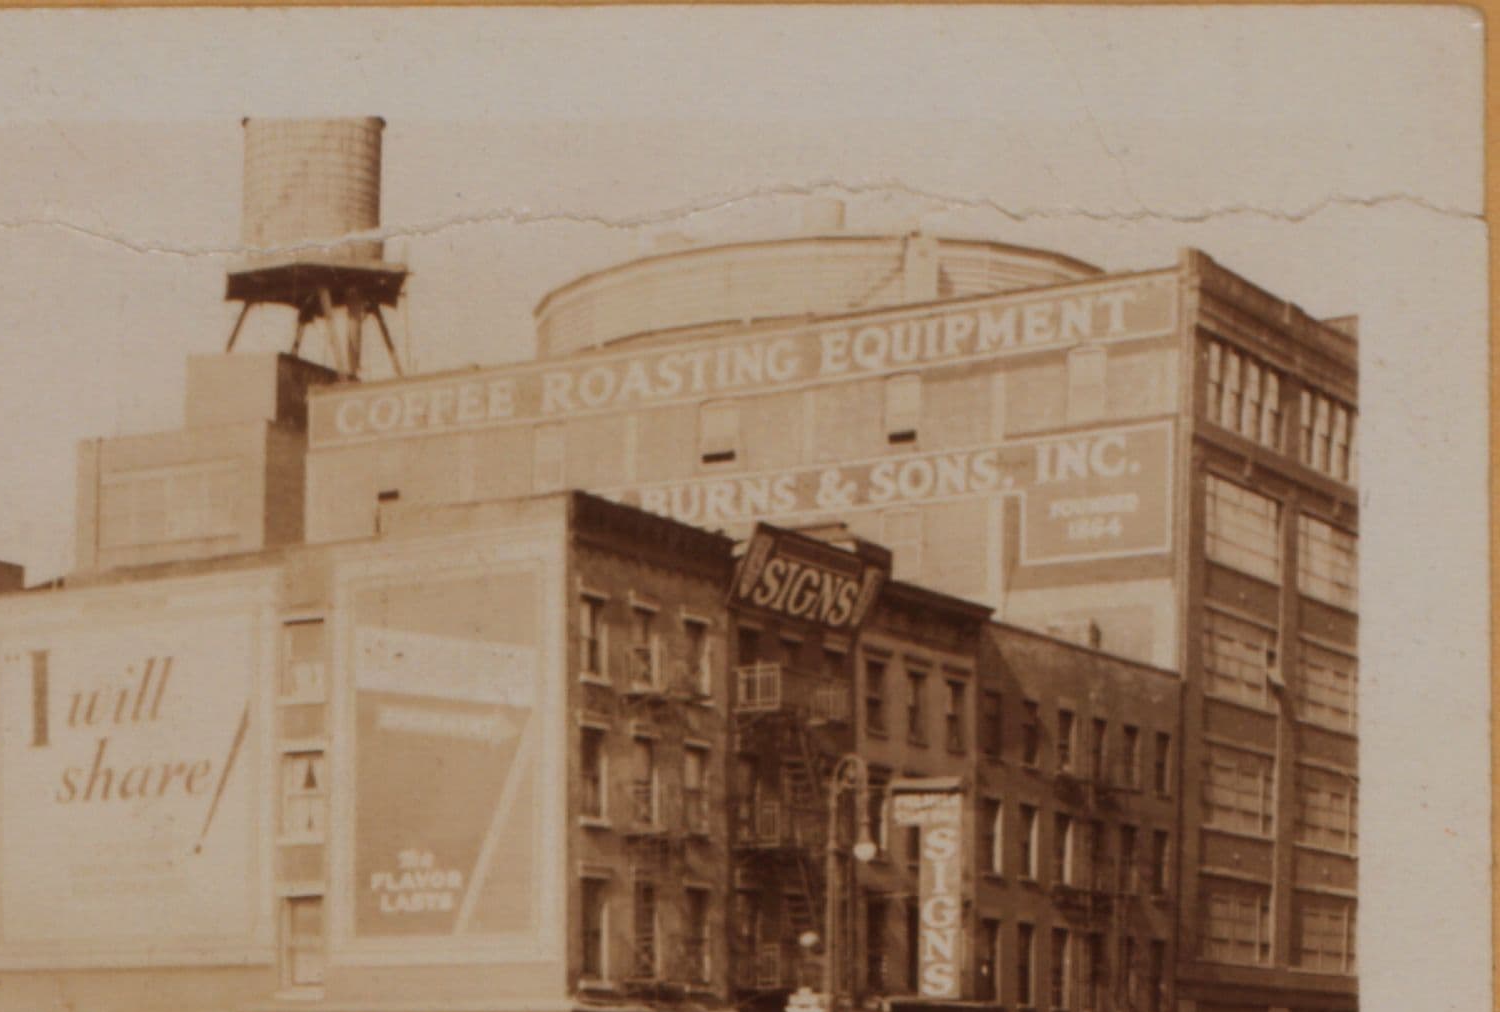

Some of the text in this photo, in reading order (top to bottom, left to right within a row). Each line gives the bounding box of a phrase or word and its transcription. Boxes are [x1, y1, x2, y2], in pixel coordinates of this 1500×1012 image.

[333, 292, 1135, 435] COFFEE ROASTING EQUIPMENT
[639, 475, 796, 522] BURNS
[815, 468, 857, 508] &
[1034, 436, 1142, 483] INC.
[752, 557, 859, 627] SIGNS
[67, 655, 174, 728] will
[371, 870, 463, 891] FLAVOR
[922, 828, 957, 996] SIGNS
